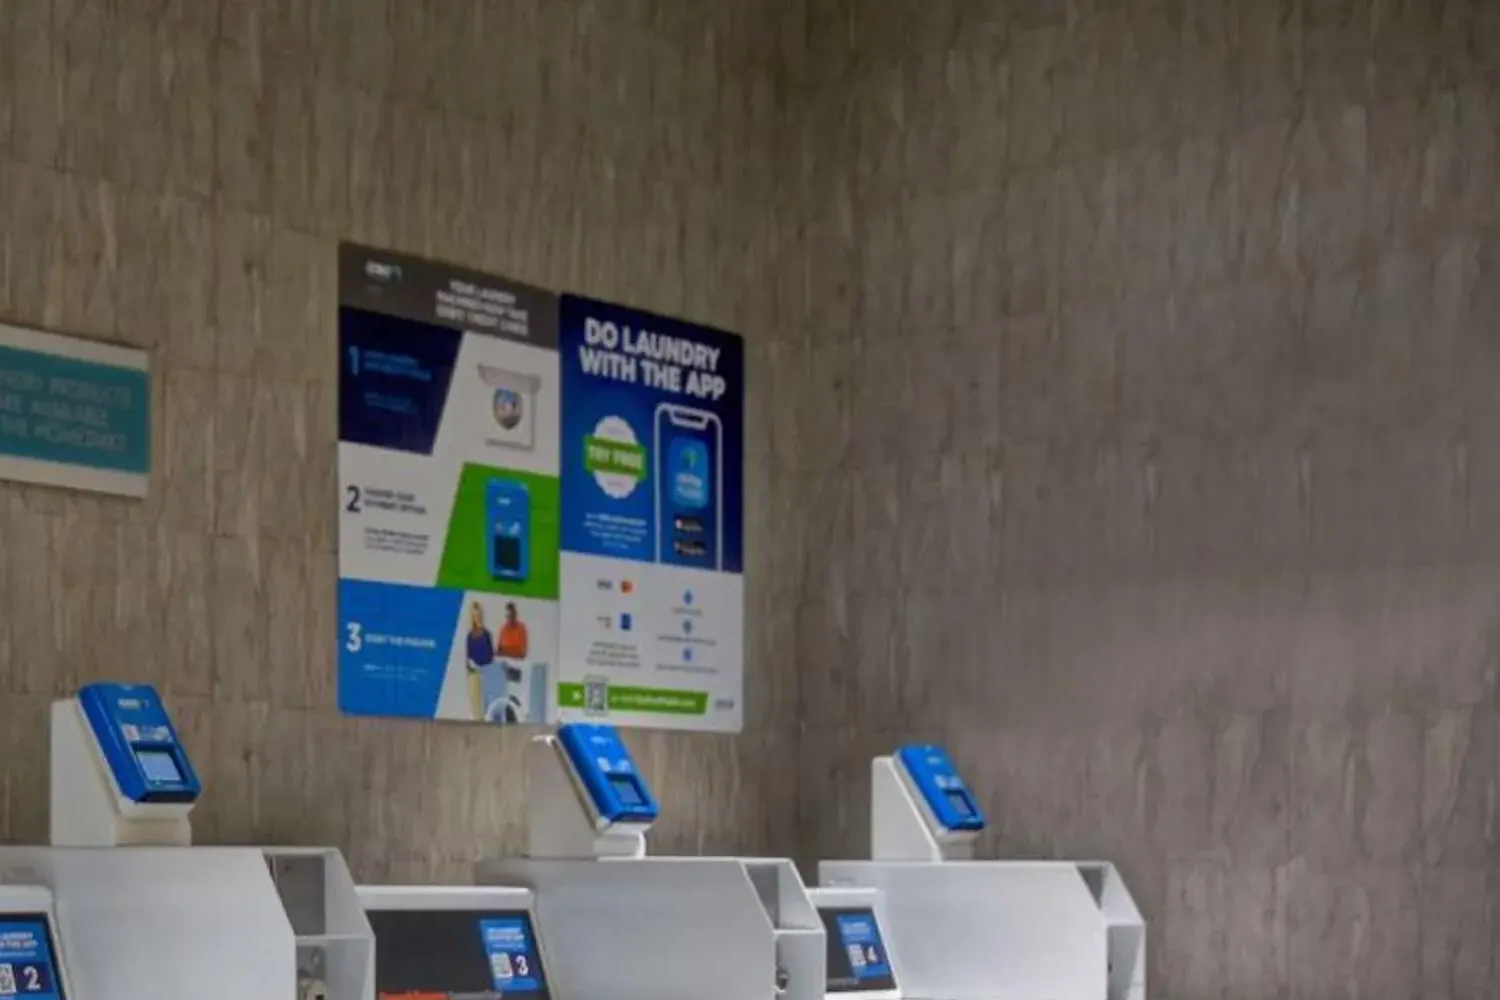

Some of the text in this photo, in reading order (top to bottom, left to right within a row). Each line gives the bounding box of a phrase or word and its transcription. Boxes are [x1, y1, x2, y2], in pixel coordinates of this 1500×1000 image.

[584, 316, 721, 371] DO LAUNDRY
[579, 345, 726, 400] WITH THE APP
[346, 485, 361, 513] 2
[346, 622, 362, 652] 3
[23, 966, 41, 990] 2
